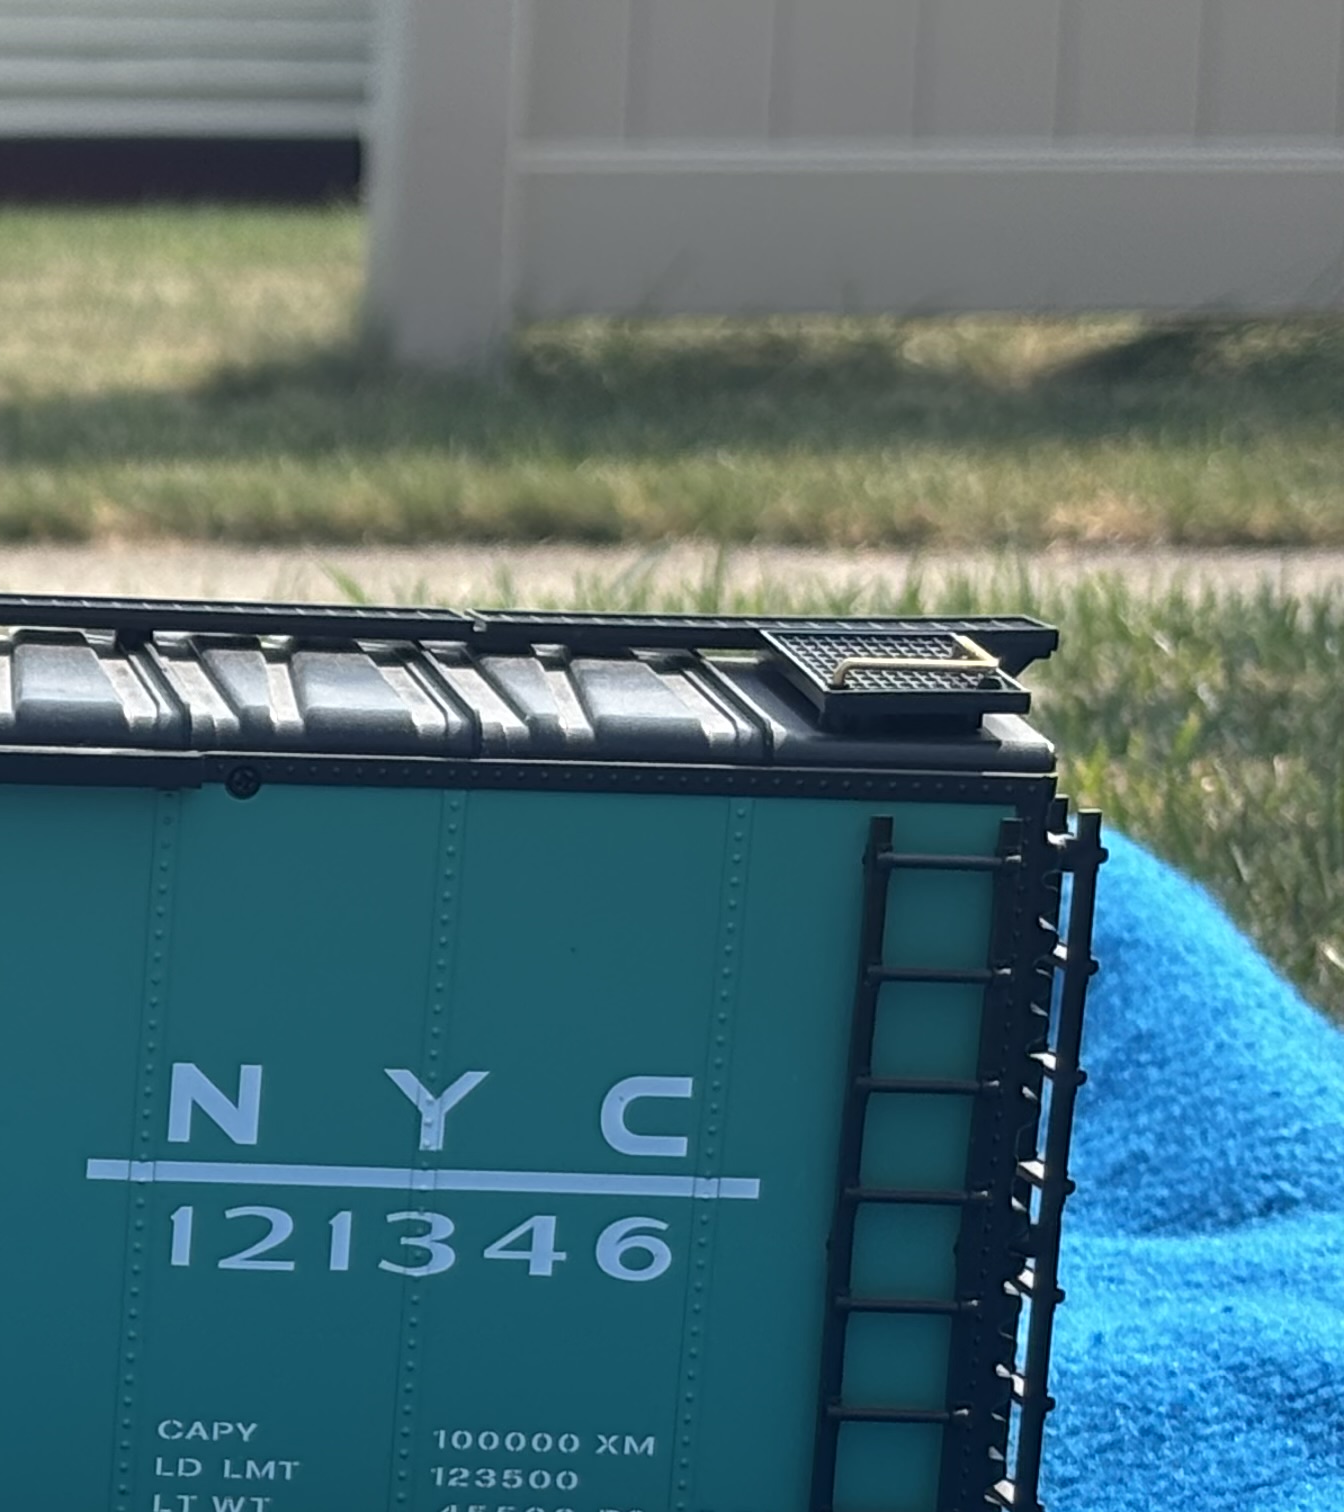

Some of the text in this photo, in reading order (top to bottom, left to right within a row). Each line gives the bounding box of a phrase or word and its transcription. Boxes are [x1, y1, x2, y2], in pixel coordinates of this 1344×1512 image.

[170, 1205, 673, 1282] 121346
[157, 1419, 655, 1456] CAPY 100000 XM
[155, 1456, 579, 1490] LD LMT 123500
